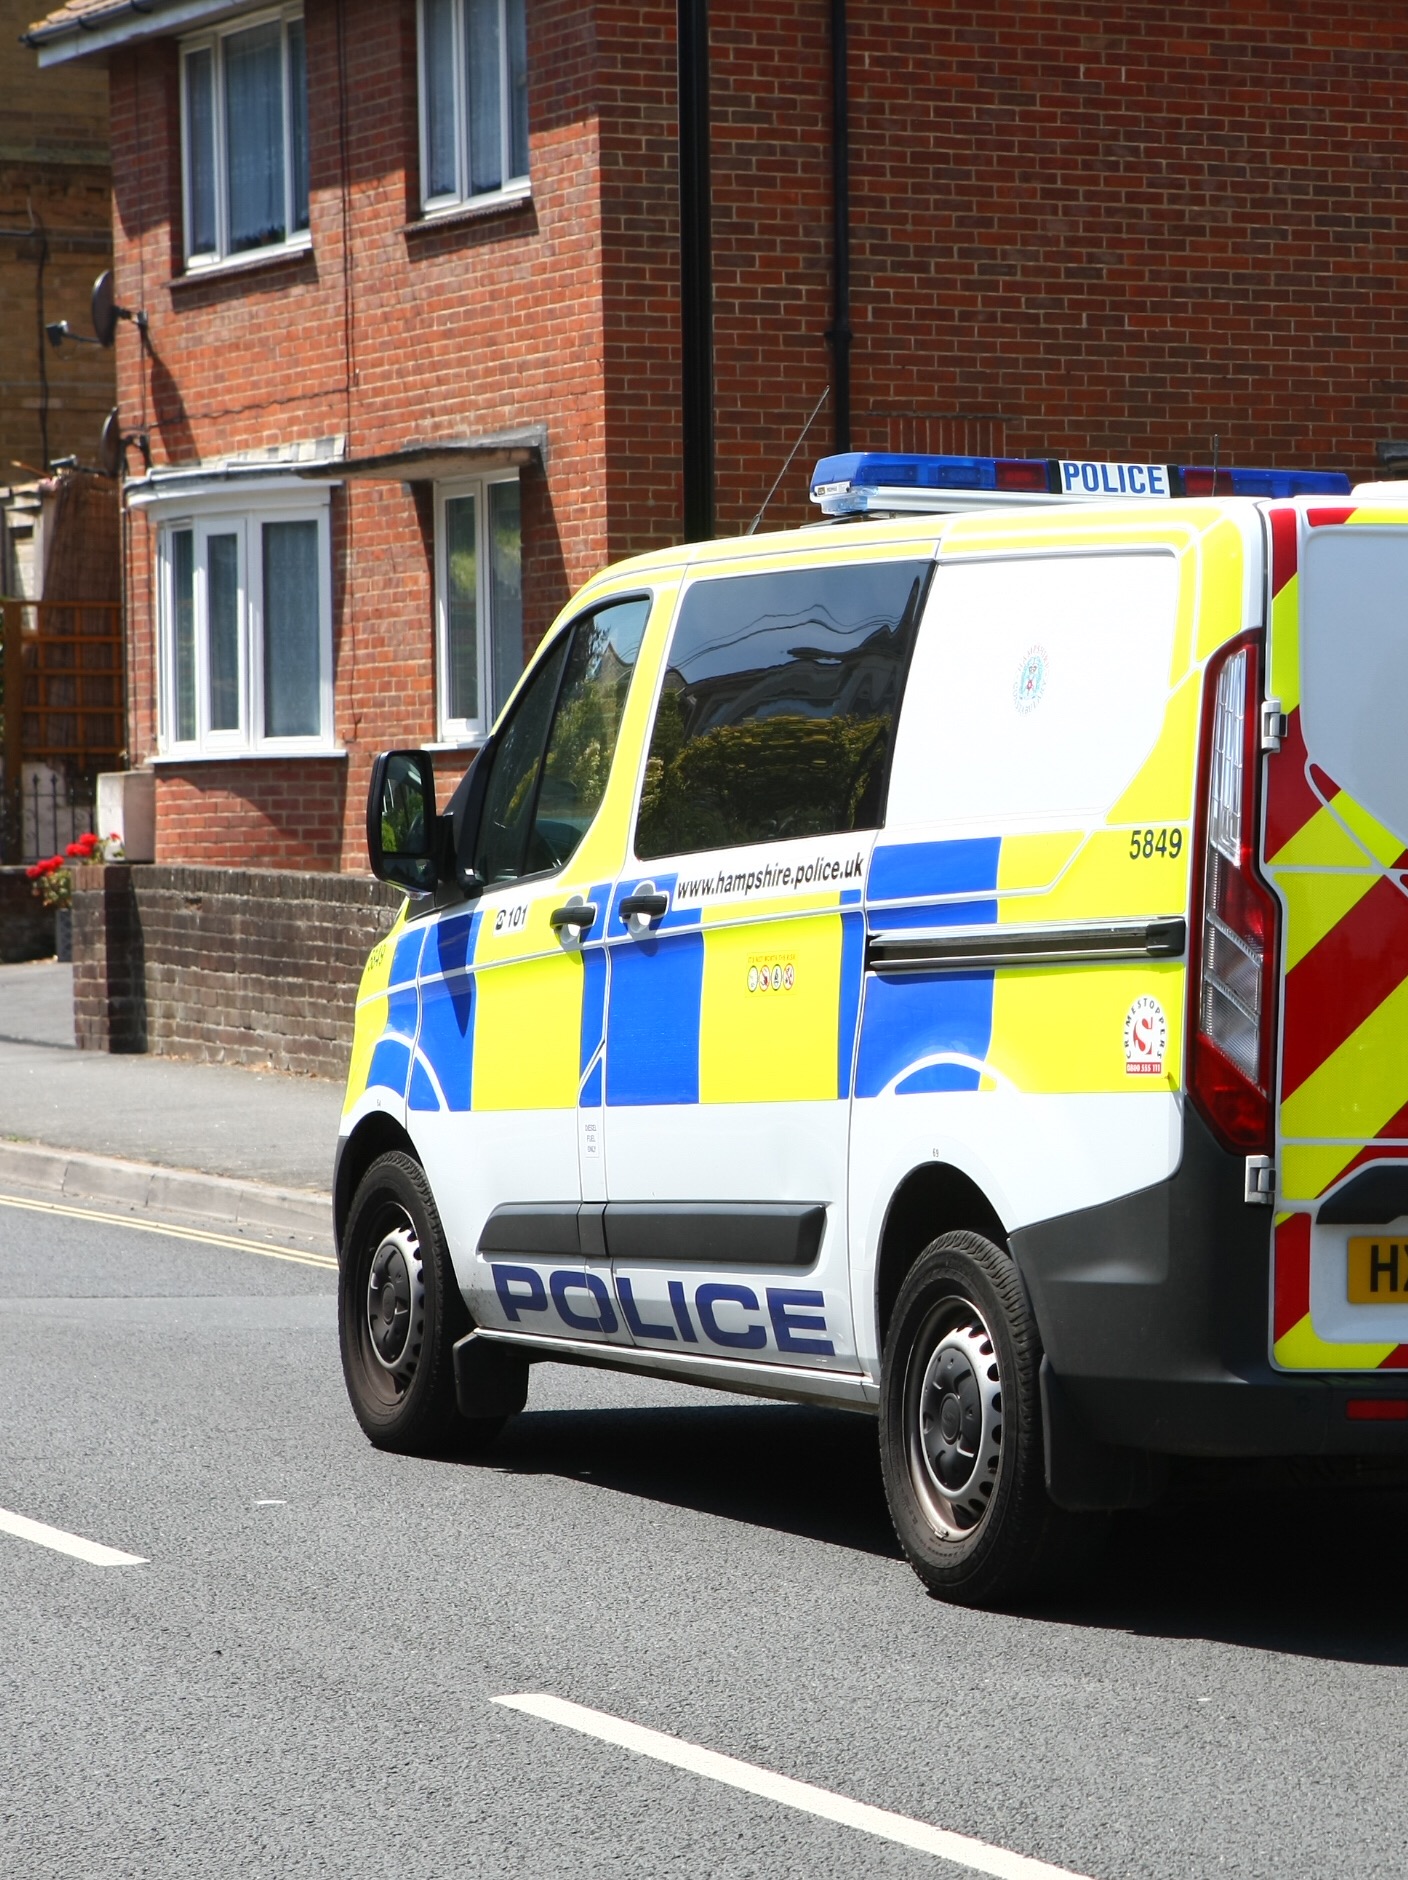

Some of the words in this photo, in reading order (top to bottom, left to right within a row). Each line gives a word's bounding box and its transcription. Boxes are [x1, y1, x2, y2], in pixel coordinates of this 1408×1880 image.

[1063, 462, 1165, 494] POLICE
[1129, 828, 1182, 860] 5849
[678, 852, 865, 899] www.hampshire.police.uk
[508, 904, 528, 928] 101
[1124, 997, 1166, 1059] CRIMESTOPPERS
[1126, 1063, 1141, 1073] 0800
[1141, 1063, 1152, 1073] 555
[1152, 1063, 1161, 1073] 111
[491, 1264, 836, 1356] POLICE
